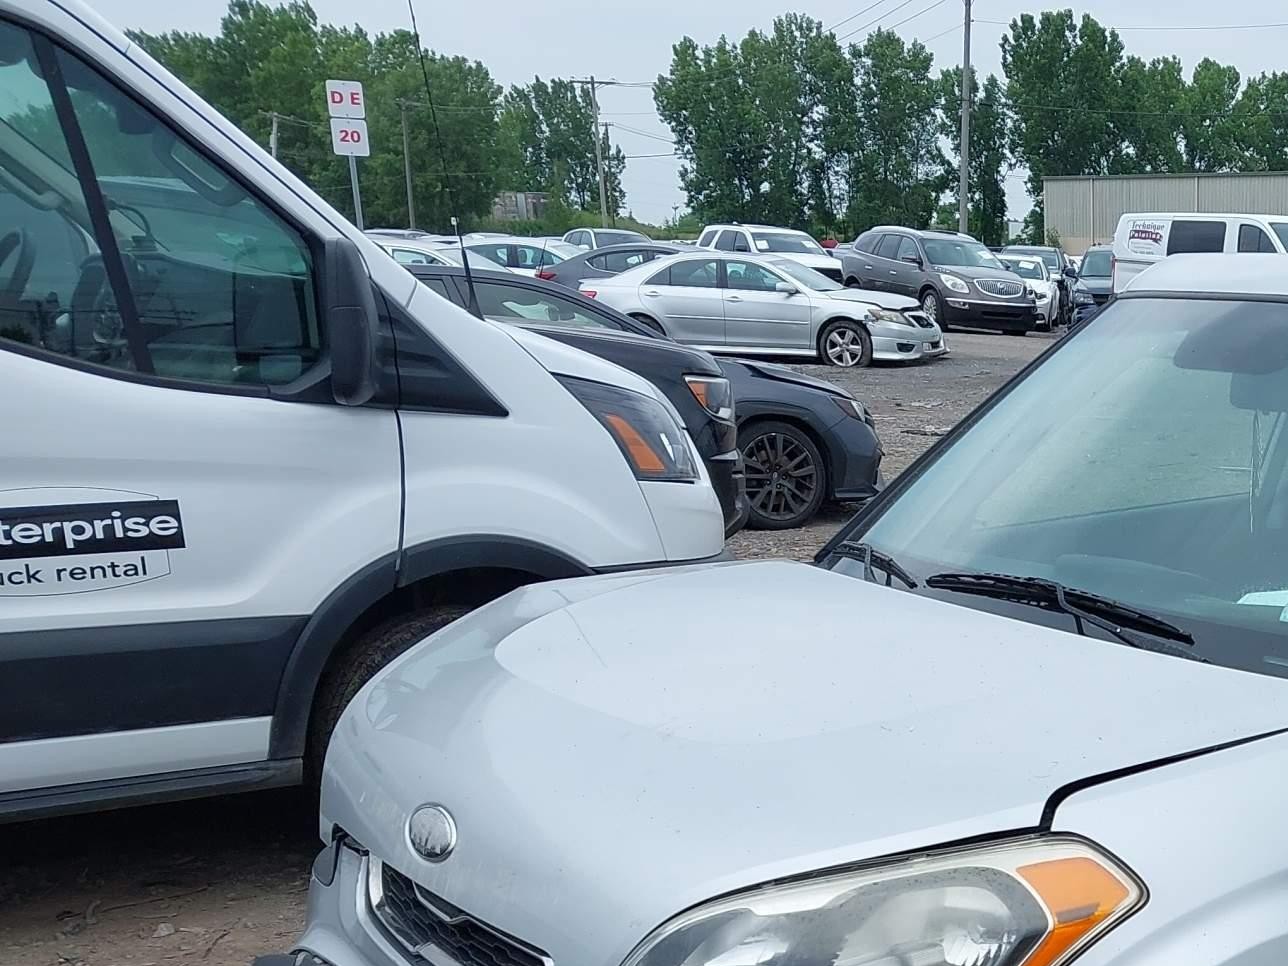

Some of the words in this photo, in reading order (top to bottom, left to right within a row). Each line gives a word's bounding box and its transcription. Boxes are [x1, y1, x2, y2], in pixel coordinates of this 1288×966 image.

[331, 91, 343, 104] D
[350, 92, 360, 105] E
[340, 130, 361, 143] 20
[56, 556, 148, 582] rental
